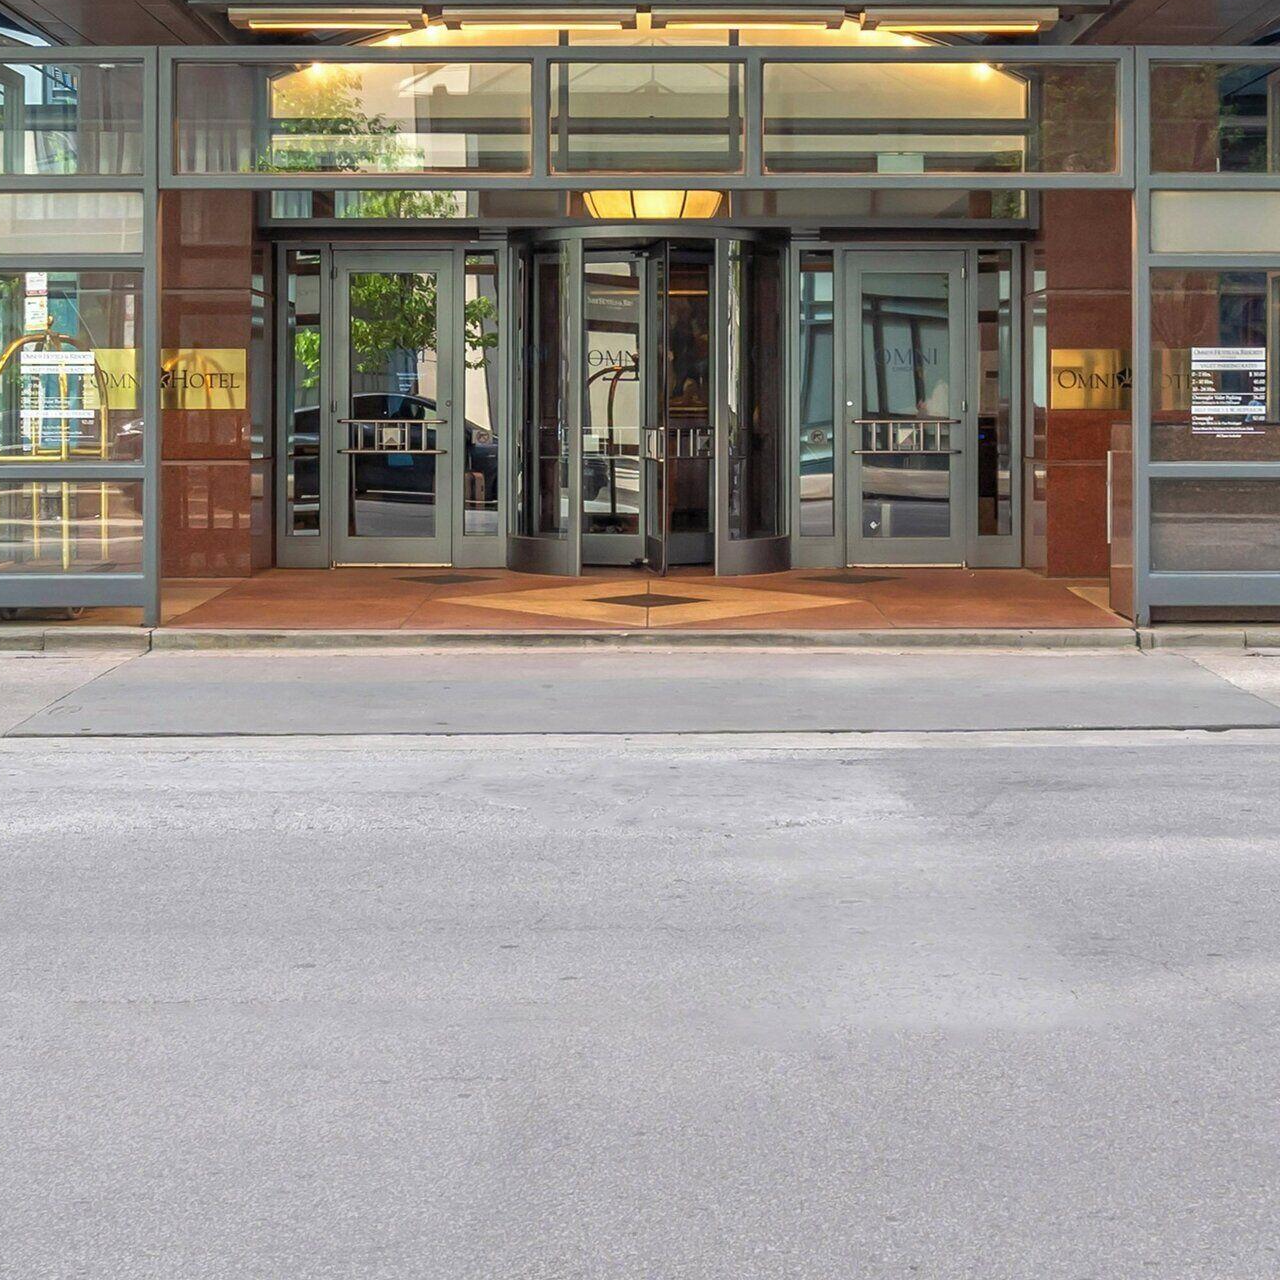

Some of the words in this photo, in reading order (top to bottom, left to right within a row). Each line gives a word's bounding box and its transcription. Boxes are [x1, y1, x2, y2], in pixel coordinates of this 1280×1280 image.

[588, 349, 638, 368] OMN
[90, 369, 142, 389] OMN
[171, 369, 241, 389] HOTEL
[1057, 369, 1116, 389] OMNI
